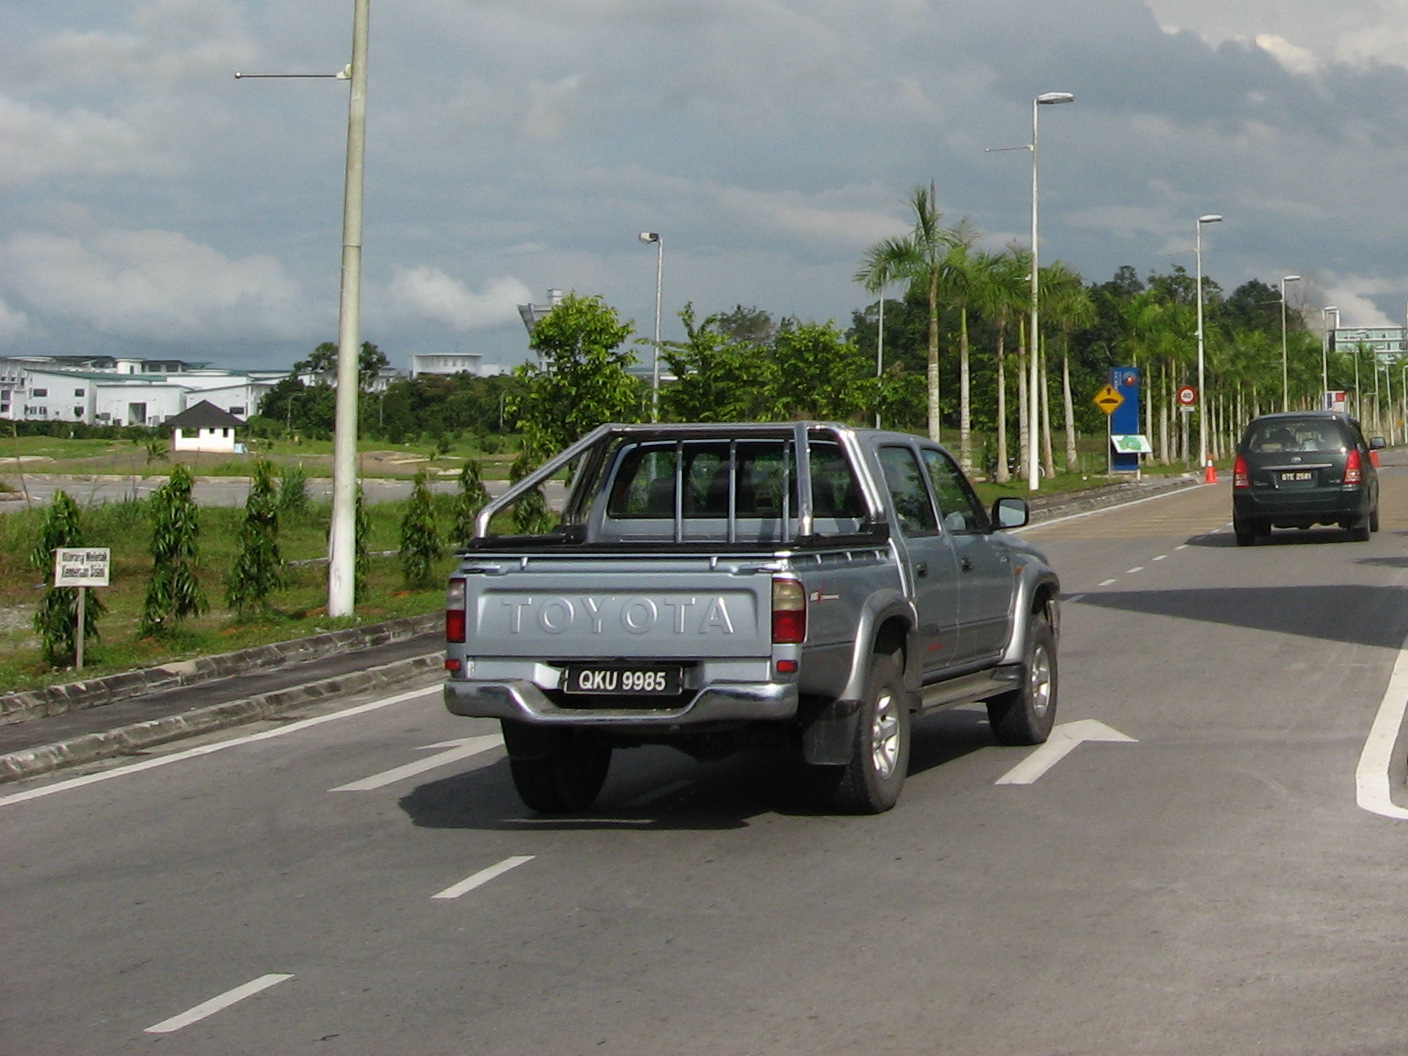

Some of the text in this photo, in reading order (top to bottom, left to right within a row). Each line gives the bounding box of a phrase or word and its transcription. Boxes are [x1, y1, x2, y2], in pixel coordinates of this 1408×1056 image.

[502, 595, 735, 635] TOYOTA
[579, 669, 666, 692] QKU 9985
